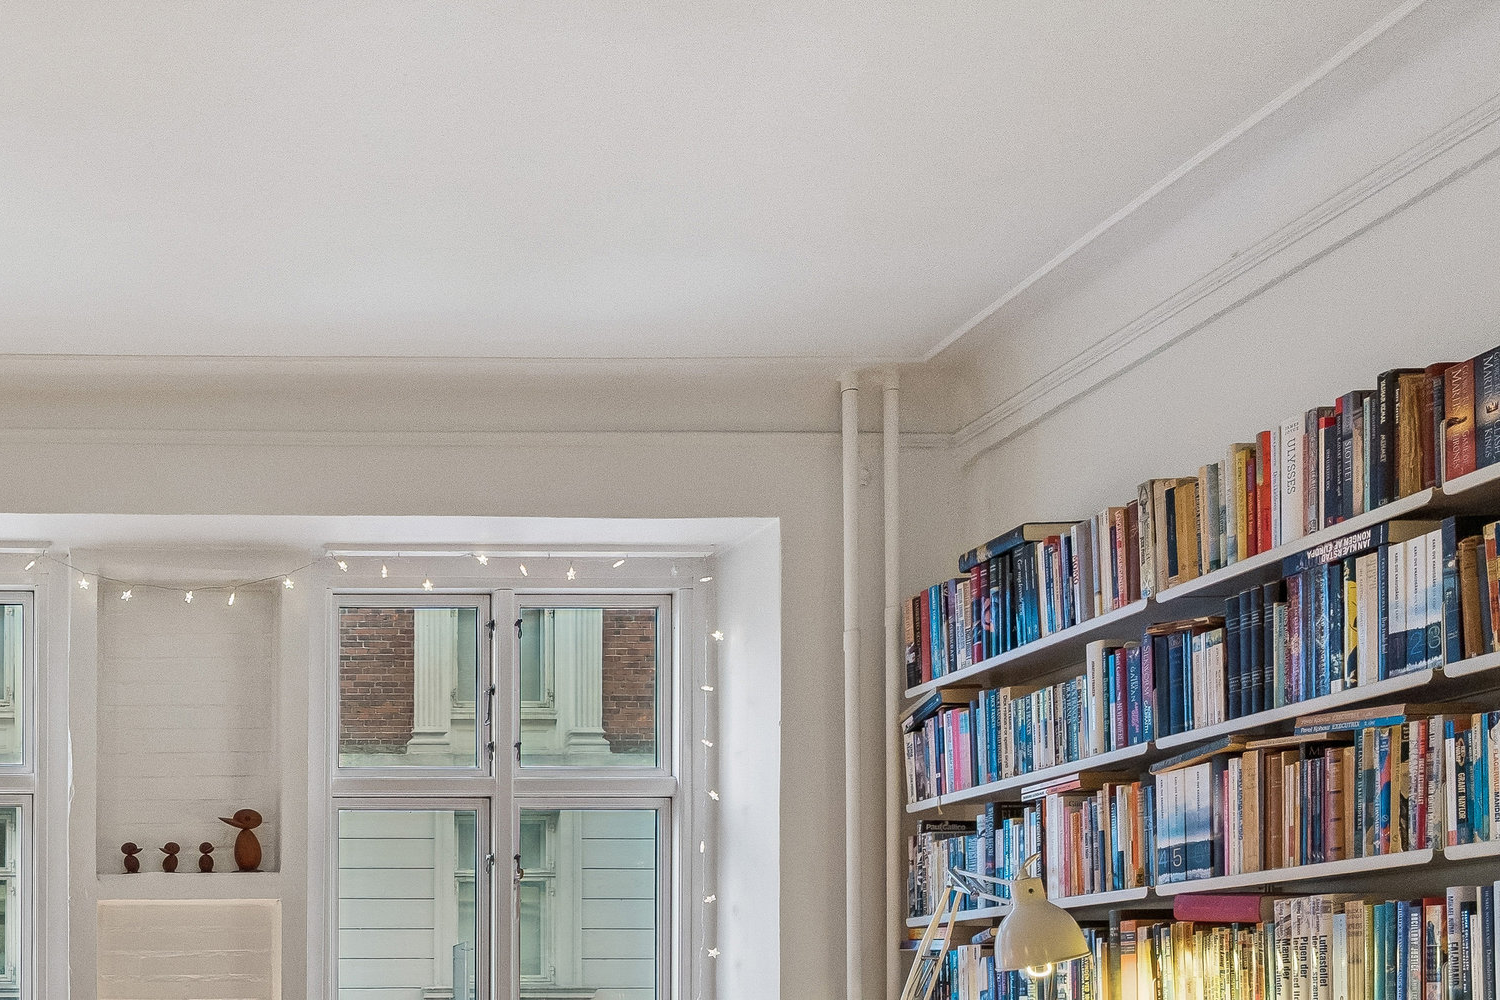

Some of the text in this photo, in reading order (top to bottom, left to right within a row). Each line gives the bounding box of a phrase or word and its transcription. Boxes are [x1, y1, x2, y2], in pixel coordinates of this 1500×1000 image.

[1286, 437, 1297, 495] ULYSSES
[1282, 938, 1290, 964] Mænd
[1319, 935, 1328, 988] Luftkastellet
